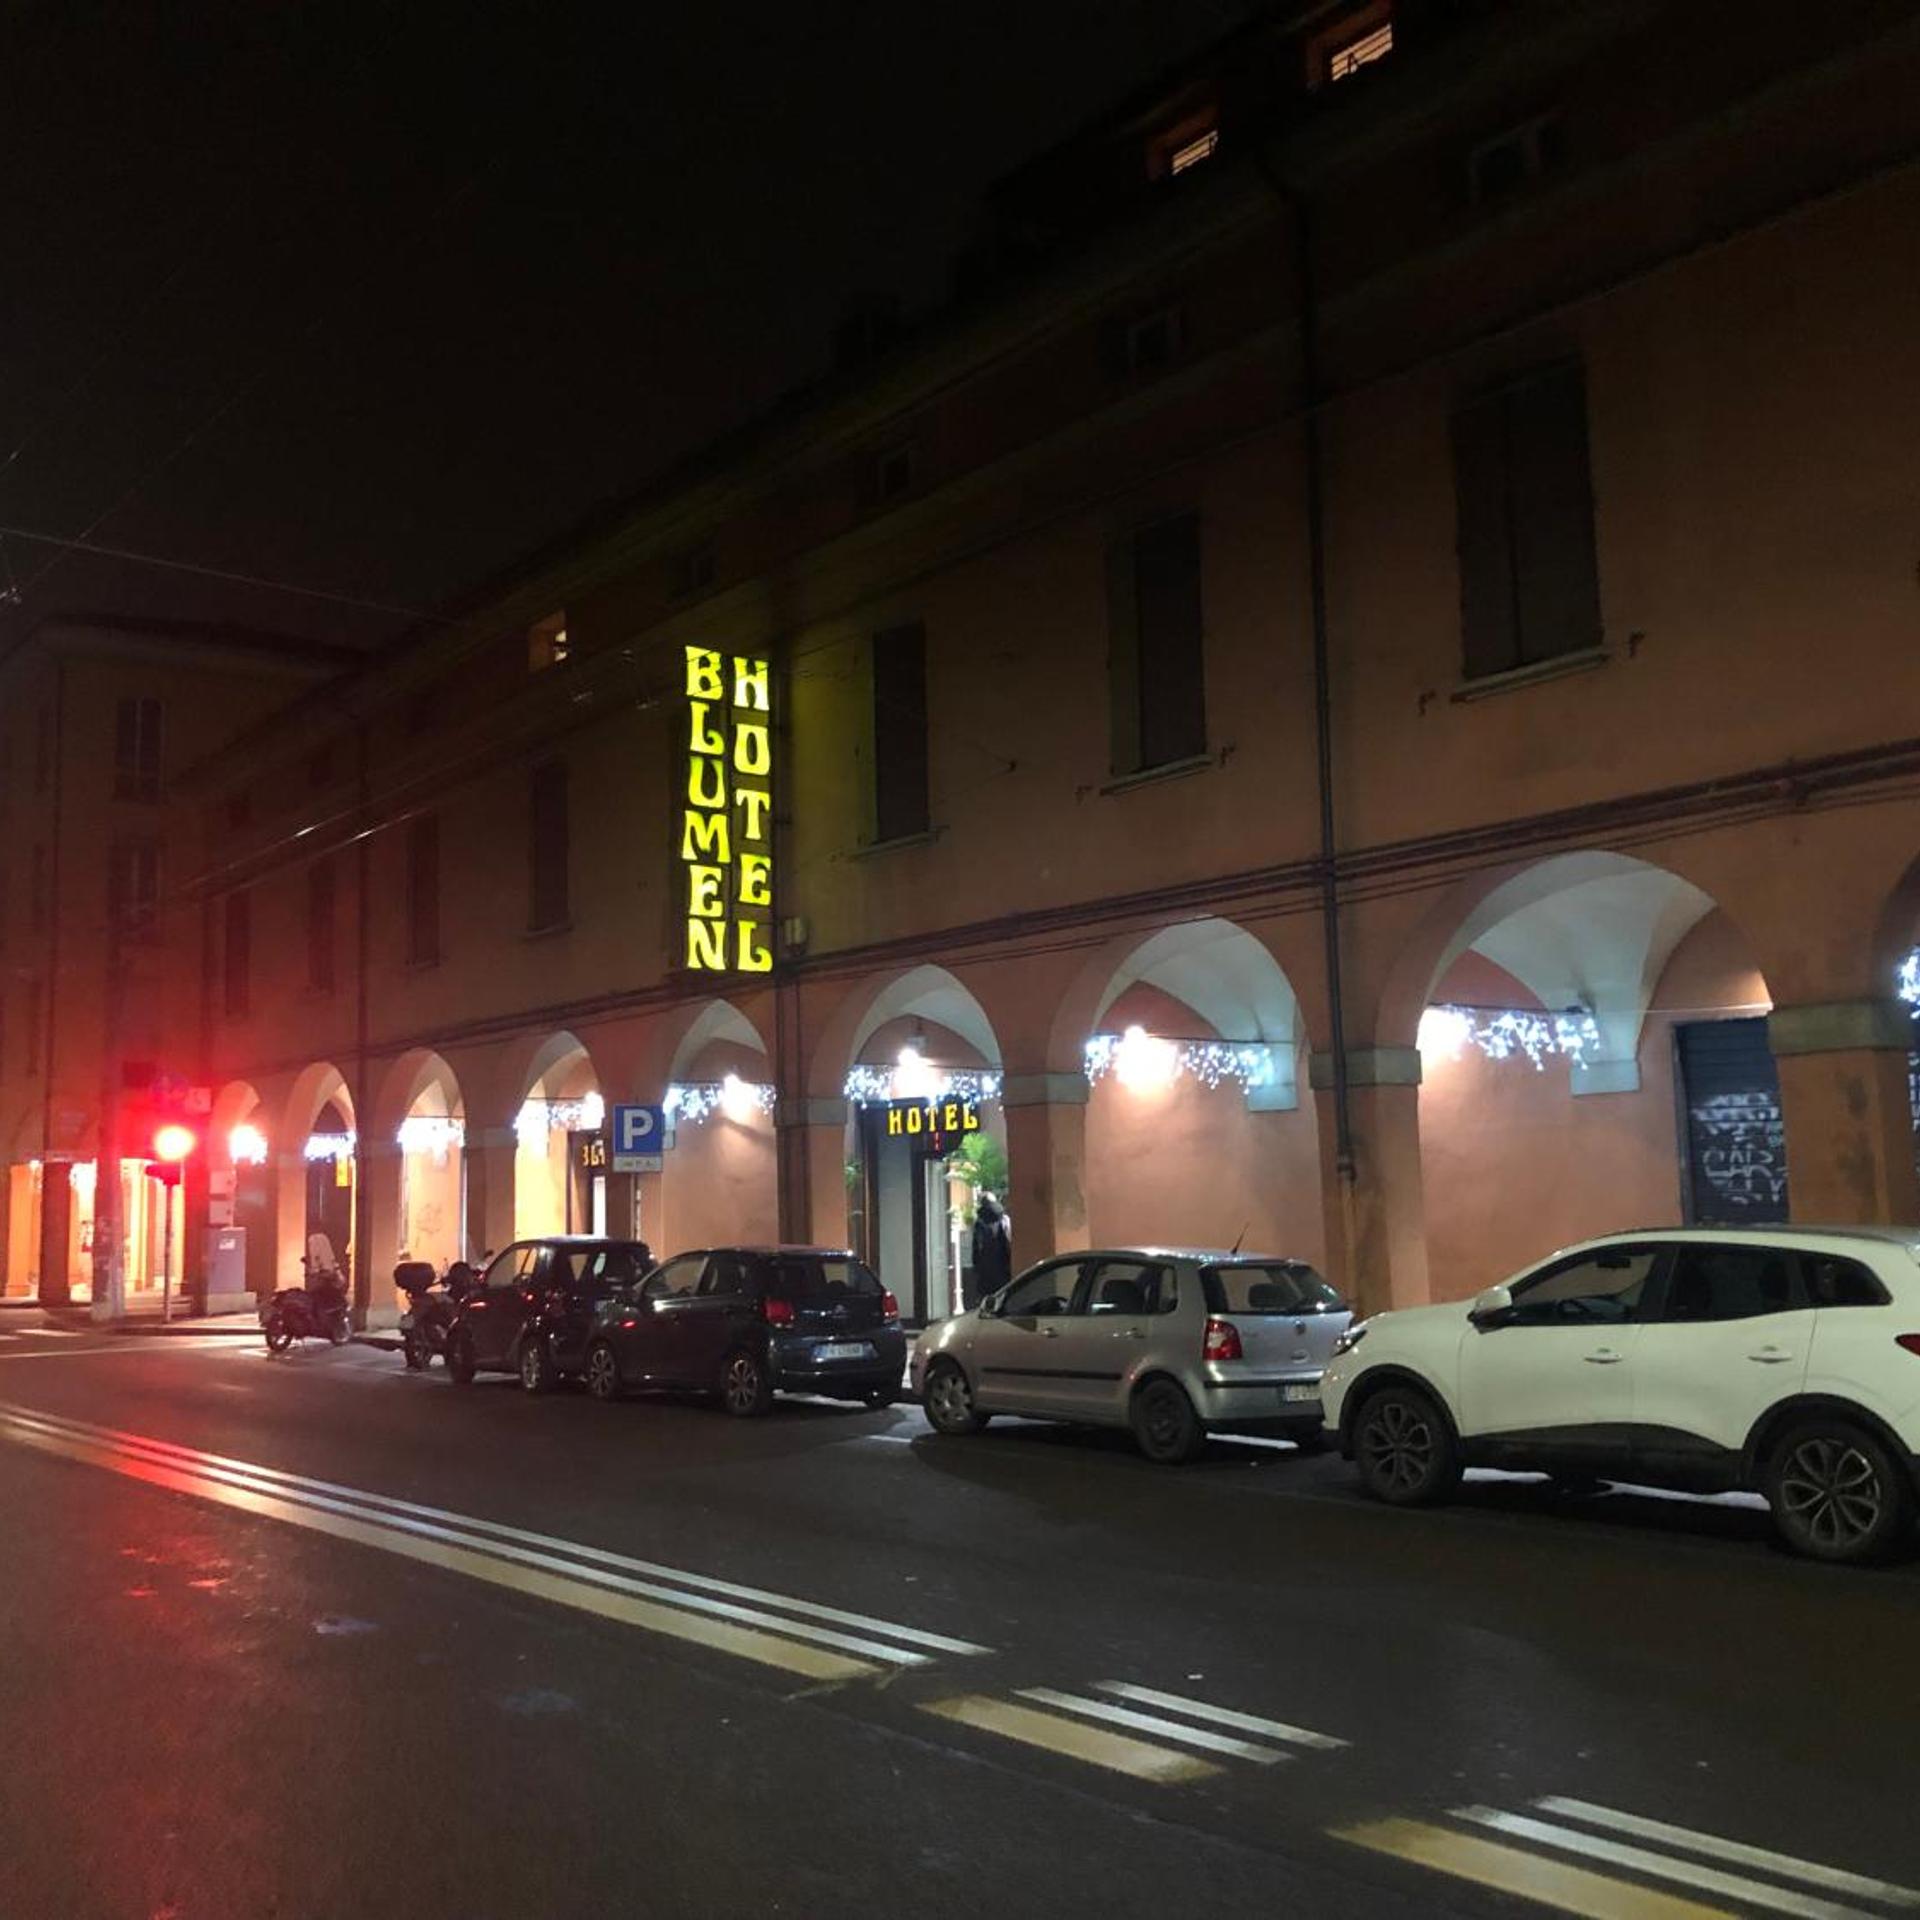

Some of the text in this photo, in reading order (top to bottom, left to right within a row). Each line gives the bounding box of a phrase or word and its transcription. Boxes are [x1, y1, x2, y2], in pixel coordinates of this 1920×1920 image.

[682, 645, 731, 971] BLUMEN
[732, 656, 773, 973] HOTEL
[623, 1109, 653, 1149] P
[888, 1103, 978, 1135] HOTEL
